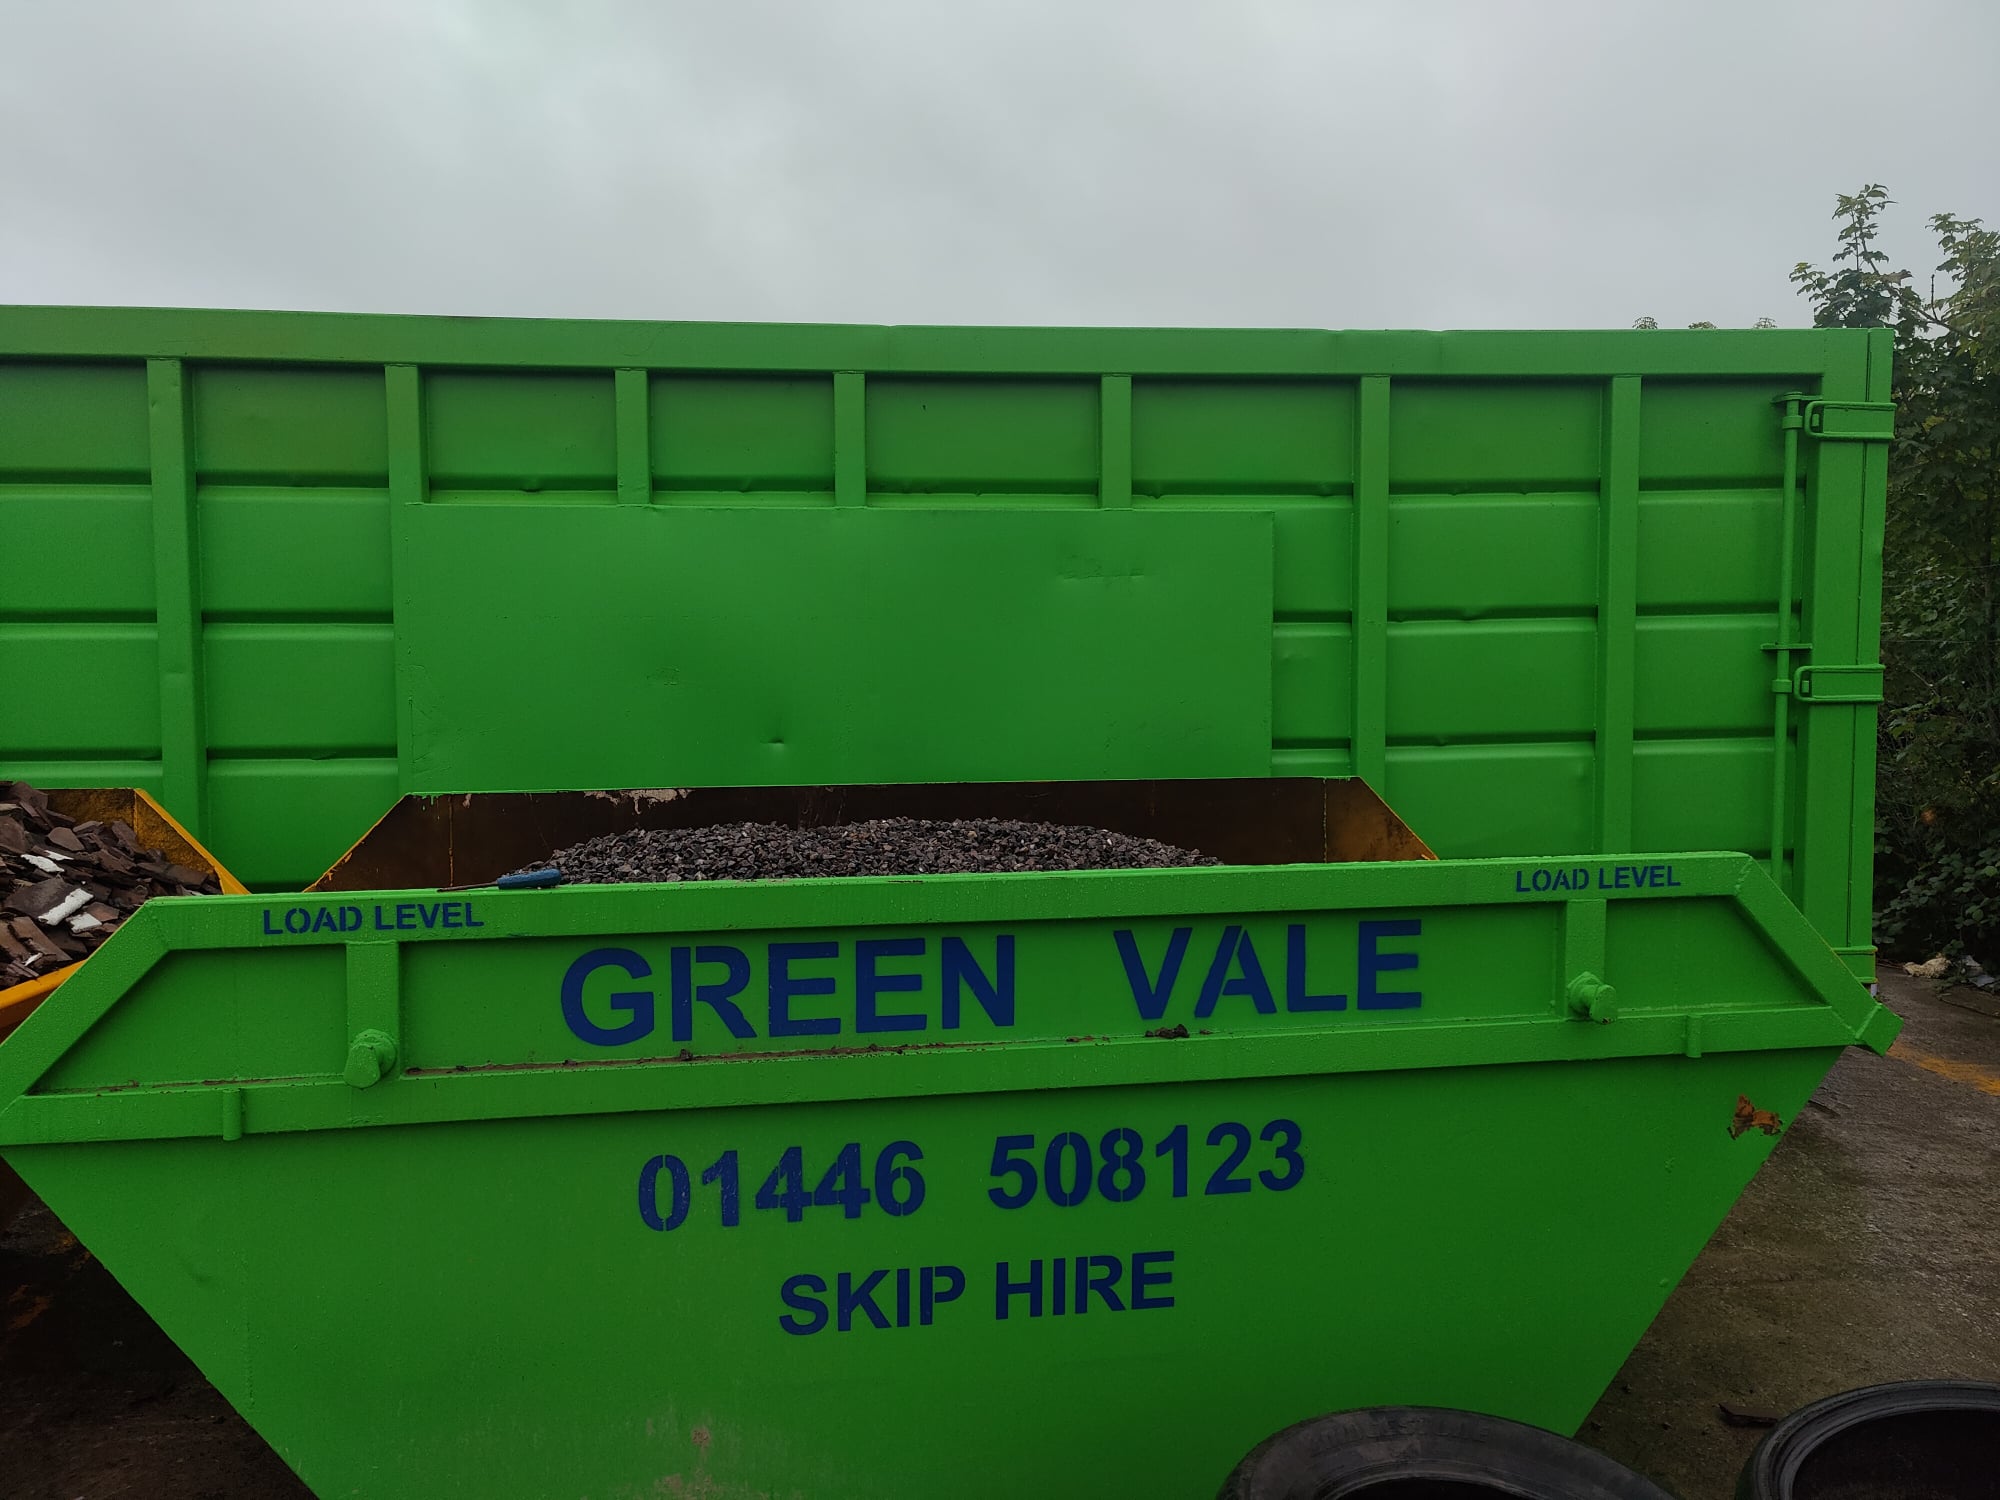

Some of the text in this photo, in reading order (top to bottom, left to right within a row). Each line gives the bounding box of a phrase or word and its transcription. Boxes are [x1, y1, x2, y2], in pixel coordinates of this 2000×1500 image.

[263, 902, 485, 935] LOAD LEVEL
[1515, 865, 1682, 893] LOAD LEVEL
[561, 919, 1422, 1046] GREEN VALE
[638, 1118, 1306, 1232] 01446 508123
[779, 1250, 1175, 1336] SKIP HIRE
